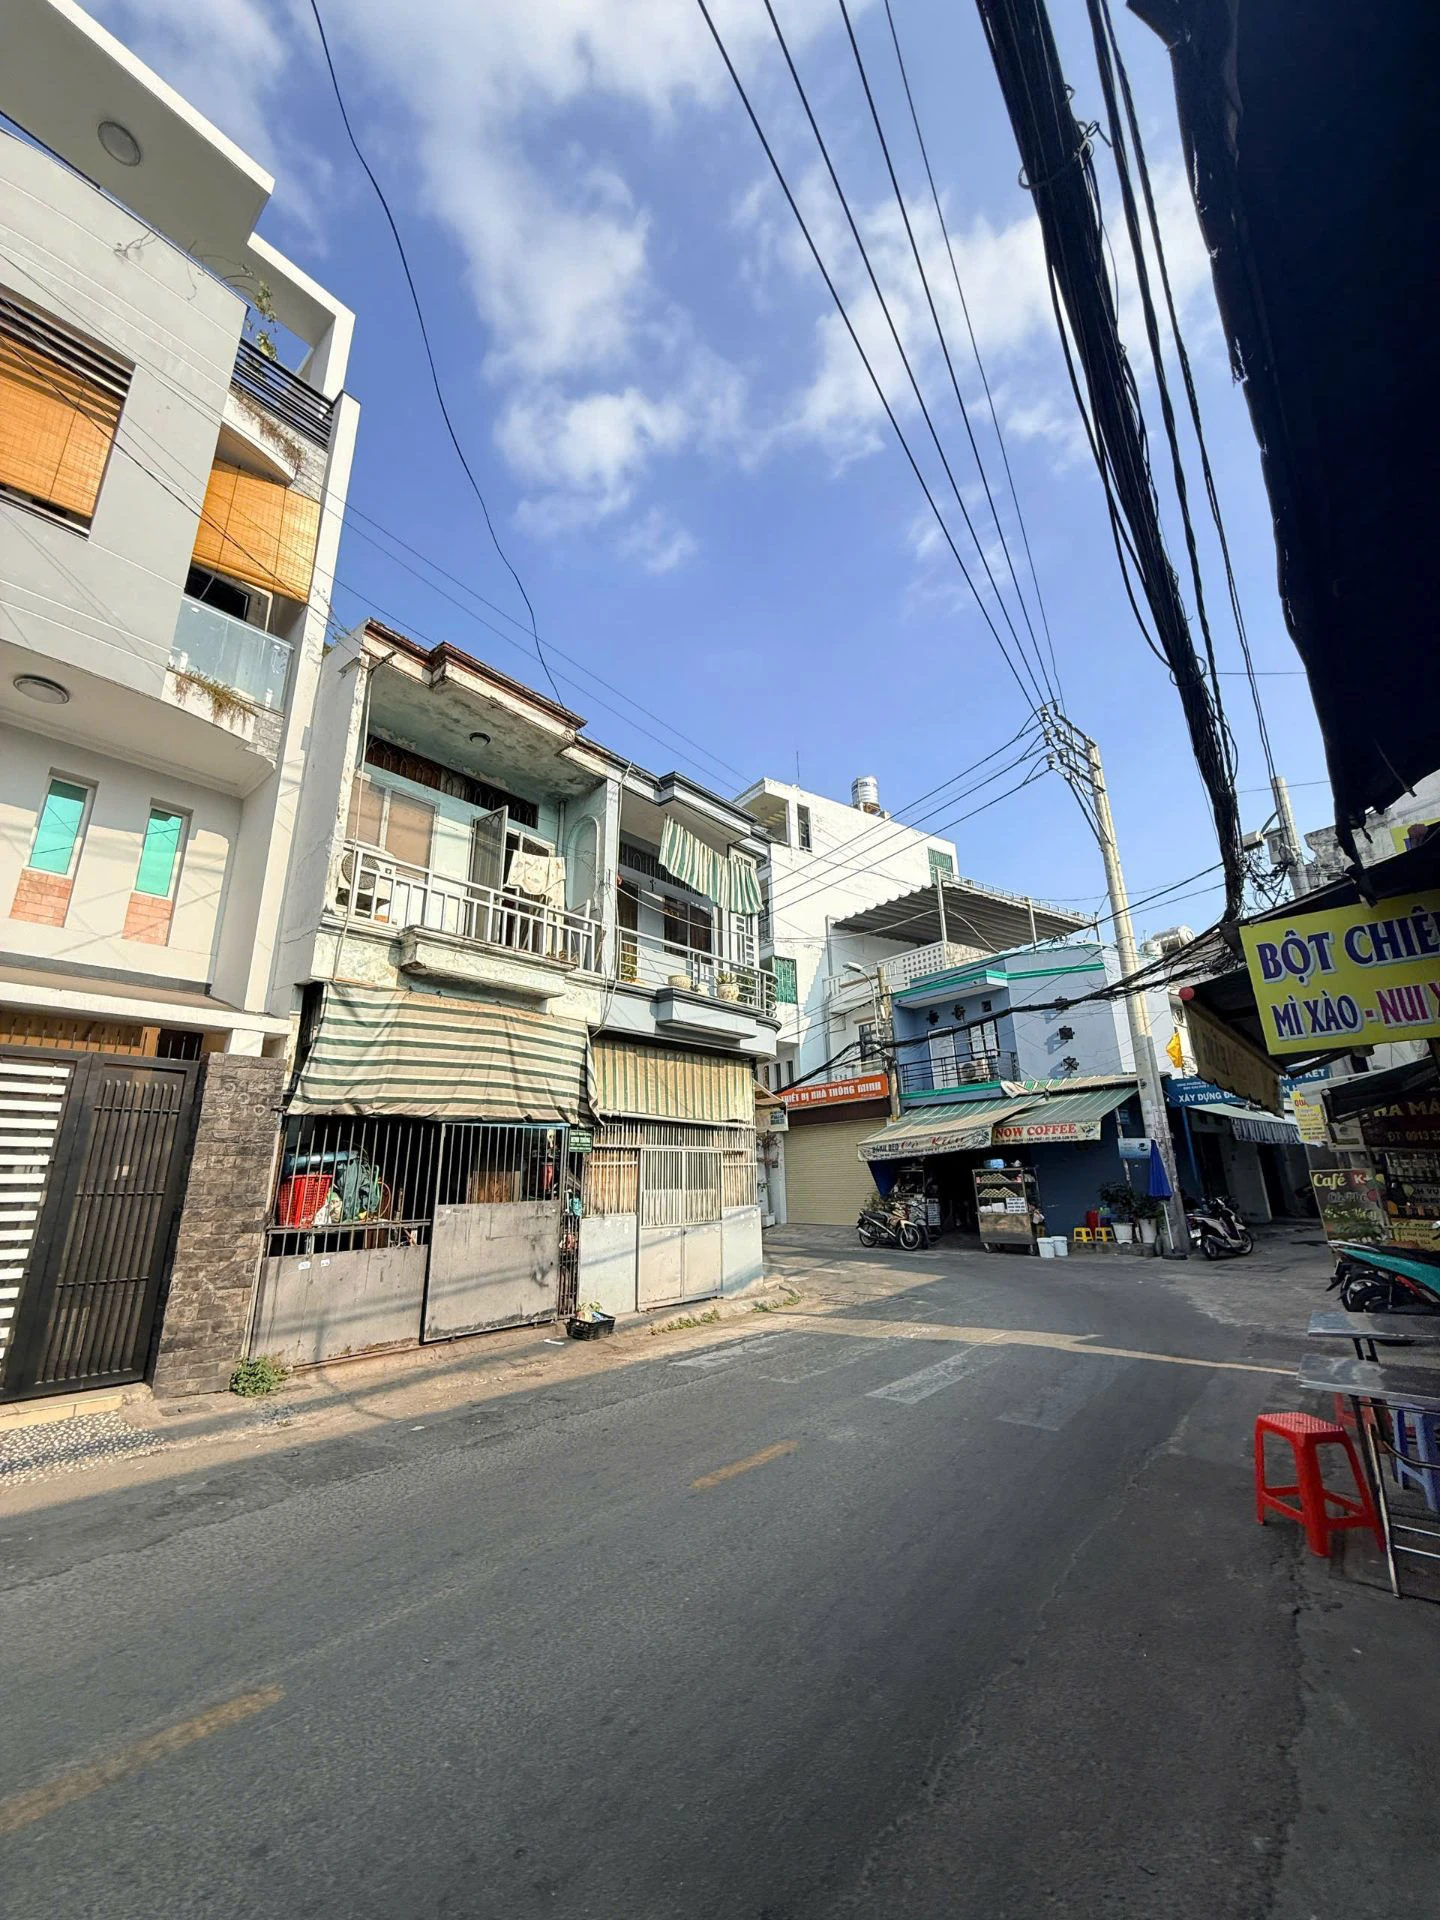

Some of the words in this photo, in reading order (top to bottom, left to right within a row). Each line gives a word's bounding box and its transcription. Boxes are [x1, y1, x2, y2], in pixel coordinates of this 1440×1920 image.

[1256, 930, 1334, 985] BỘT
[1344, 906, 1440, 966] CHIÊ
[1271, 995, 1305, 1039] MÌ
[1303, 991, 1362, 1034] XÀO
[1376, 984, 1430, 1026] NUI
[801, 1093, 809, 1101] BỊ
[829, 1085, 855, 1097] THÔNG
[858, 1081, 882, 1093] MINH
[1178, 1093, 1195, 1103] XÂY
[1197, 1091, 1222, 1103] DỰNG
[995, 1127, 1023, 1139] NOW
[1027, 1124, 1077, 1136] COFFEE
[1313, 1172, 1347, 1190] Café
